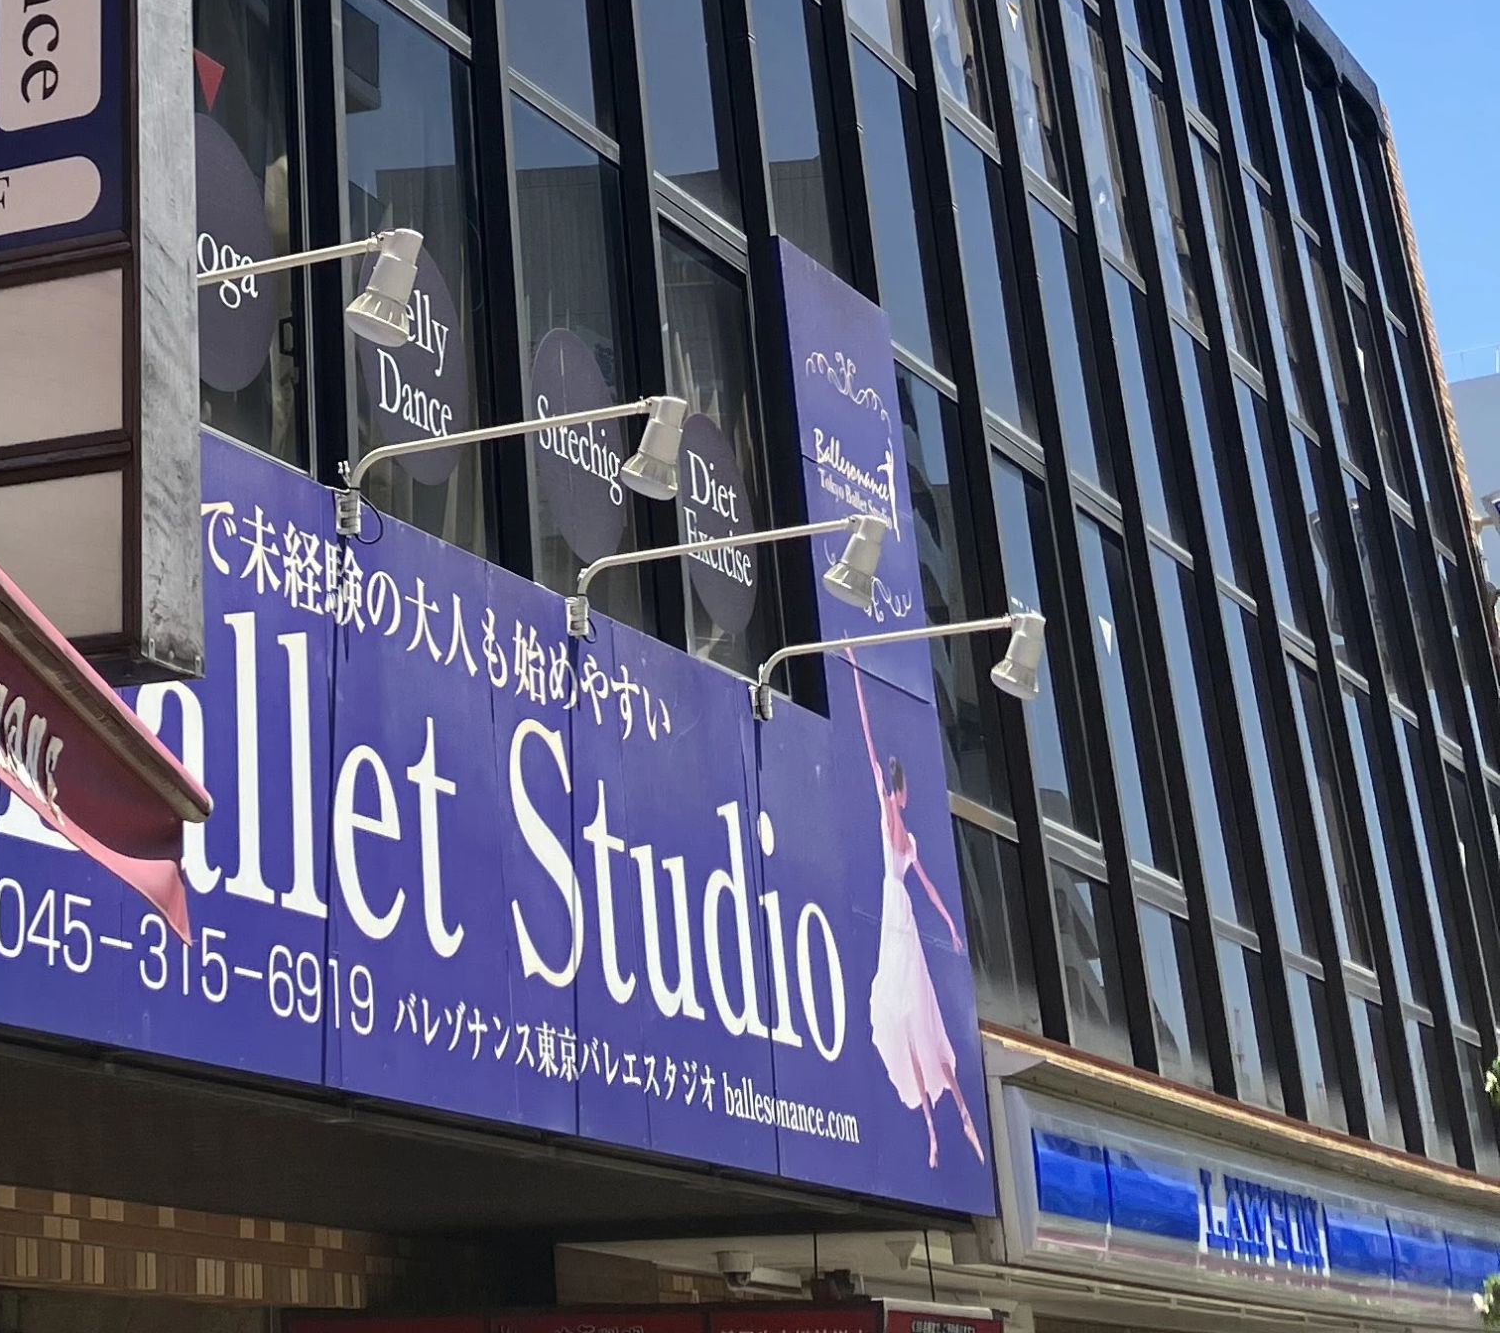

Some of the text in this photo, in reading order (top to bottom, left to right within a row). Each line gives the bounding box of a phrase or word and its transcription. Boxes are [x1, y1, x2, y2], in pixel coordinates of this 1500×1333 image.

[197, 232, 258, 309] oga
[405, 289, 449, 377] elly
[377, 348, 452, 438] Dance
[686, 449, 739, 523] Diet
[201, 501, 672, 742] で未経験の大人も始めやすい
[508, 717, 848, 1064] Studio
[393, 997, 860, 1145] バレゾナンス東京バレエスタジオ ballesonance.com
